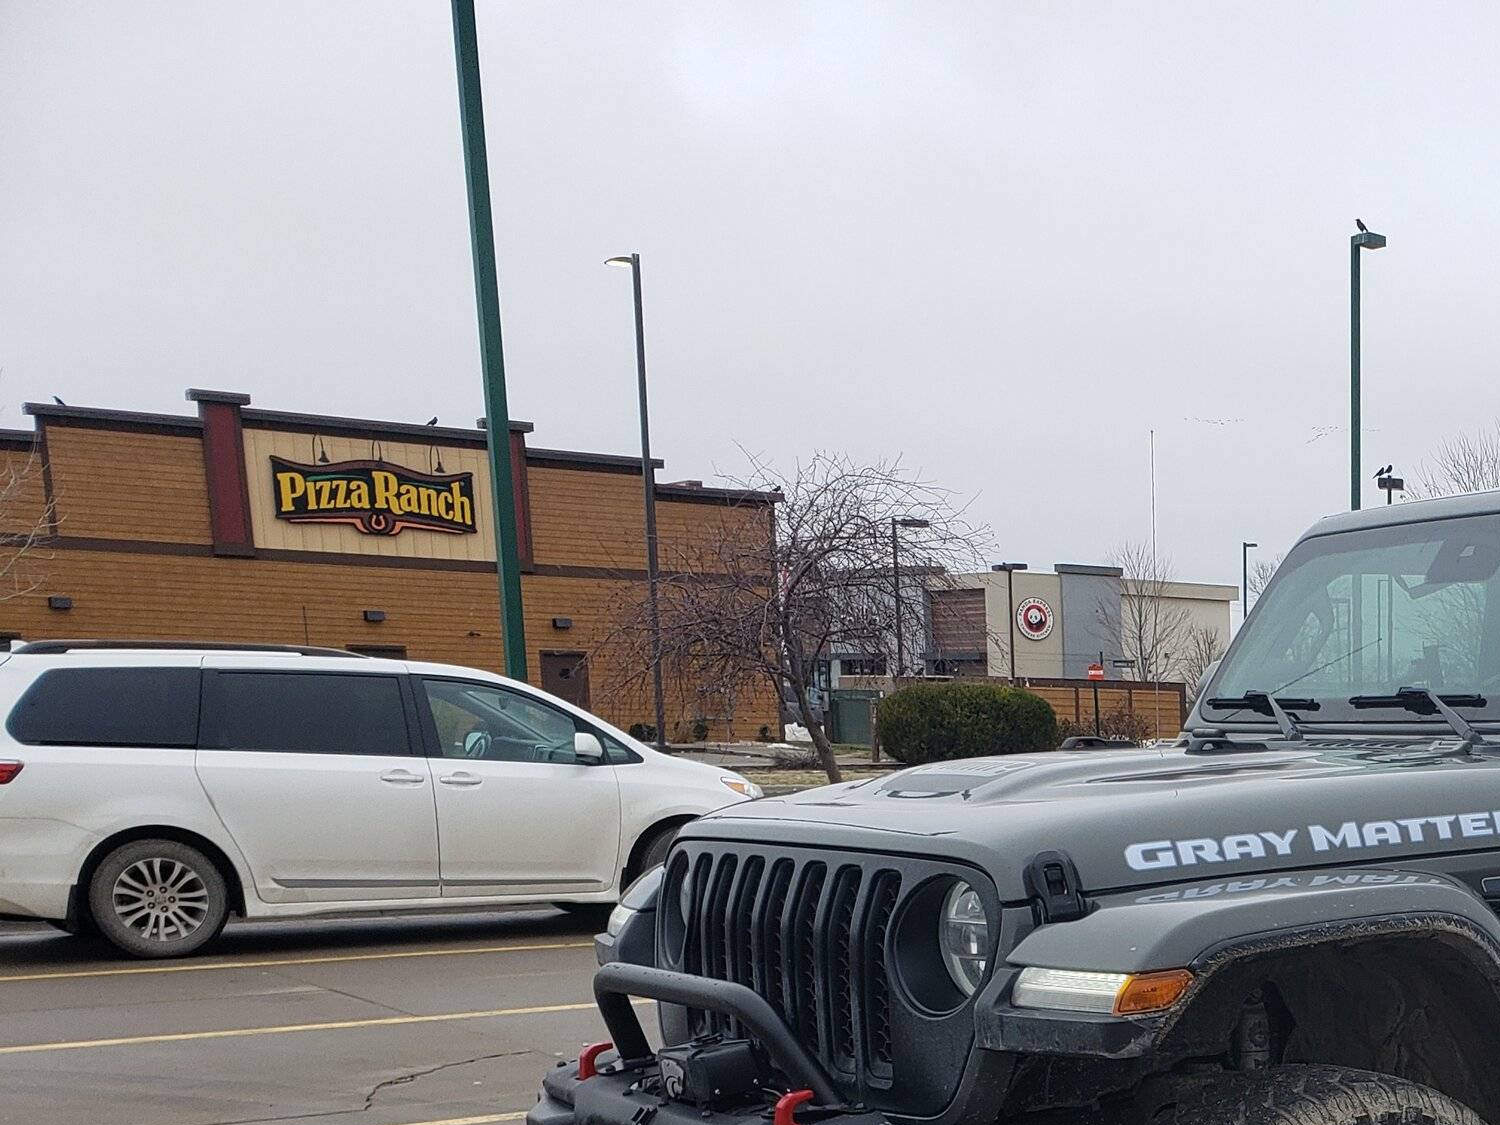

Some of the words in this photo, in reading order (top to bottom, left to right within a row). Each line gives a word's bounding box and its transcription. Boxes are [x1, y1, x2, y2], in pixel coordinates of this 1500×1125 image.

[276, 471, 371, 512] Pizza
[371, 471, 472, 525] Ranch
[1123, 828, 1299, 872] GRAY
